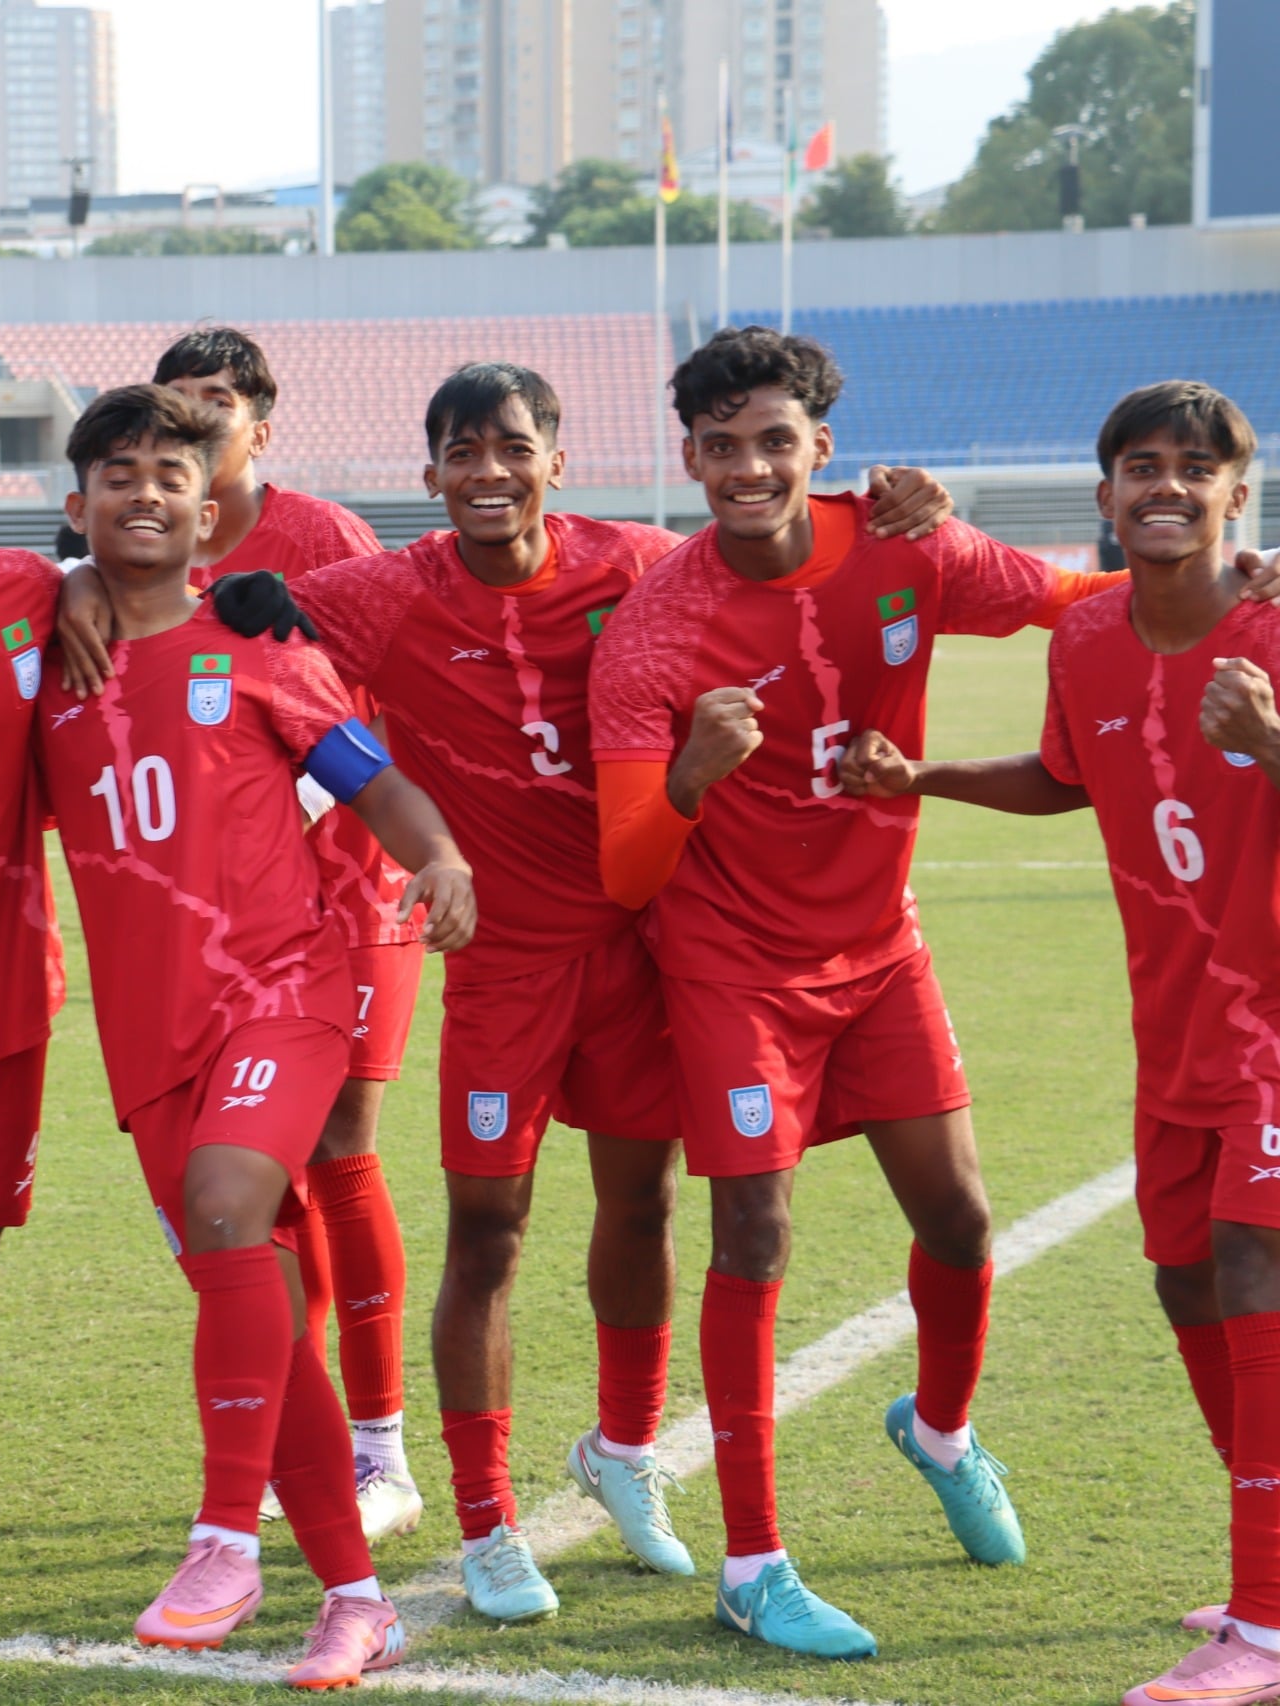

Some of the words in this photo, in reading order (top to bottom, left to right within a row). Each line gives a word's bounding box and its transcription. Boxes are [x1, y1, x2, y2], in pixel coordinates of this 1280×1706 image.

[520, 720, 573, 777] 3
[811, 719, 850, 799] 5
[90, 755, 177, 851] 10
[1153, 798, 1205, 882] 6
[356, 984, 376, 1021] 7
[231, 1056, 278, 1093] 10
